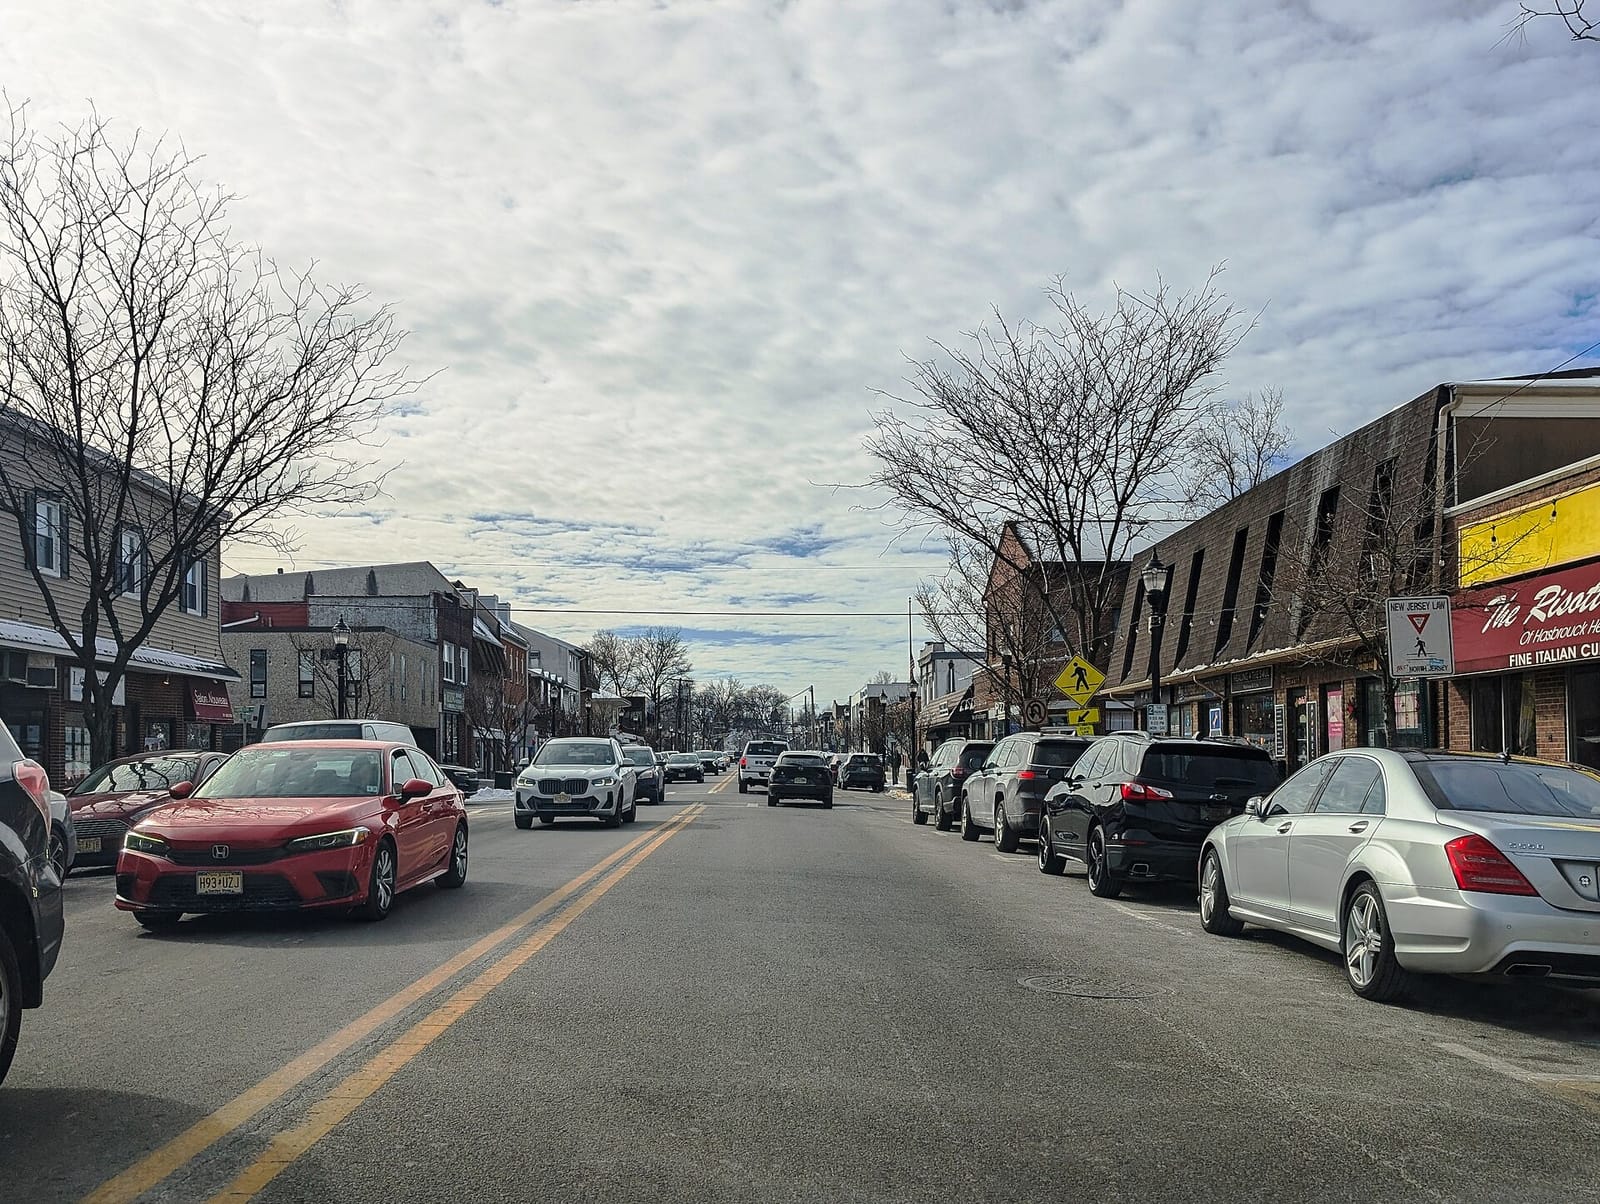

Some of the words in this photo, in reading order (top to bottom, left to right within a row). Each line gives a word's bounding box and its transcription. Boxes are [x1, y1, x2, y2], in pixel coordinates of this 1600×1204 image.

[1390, 602, 1405, 612] NEW
[1406, 601, 1430, 611] JERSEY
[1431, 601, 1445, 610] LAW
[1481, 592, 1520, 634] The
[1519, 630, 1534, 645] Of
[1532, 621, 1588, 643] Hasbrouck
[1509, 652, 1532, 667] FINE
[1535, 645, 1577, 664] ITALIAN
[194, 689, 207, 704] Salon
[207, 690, 229, 705] Nouveau
